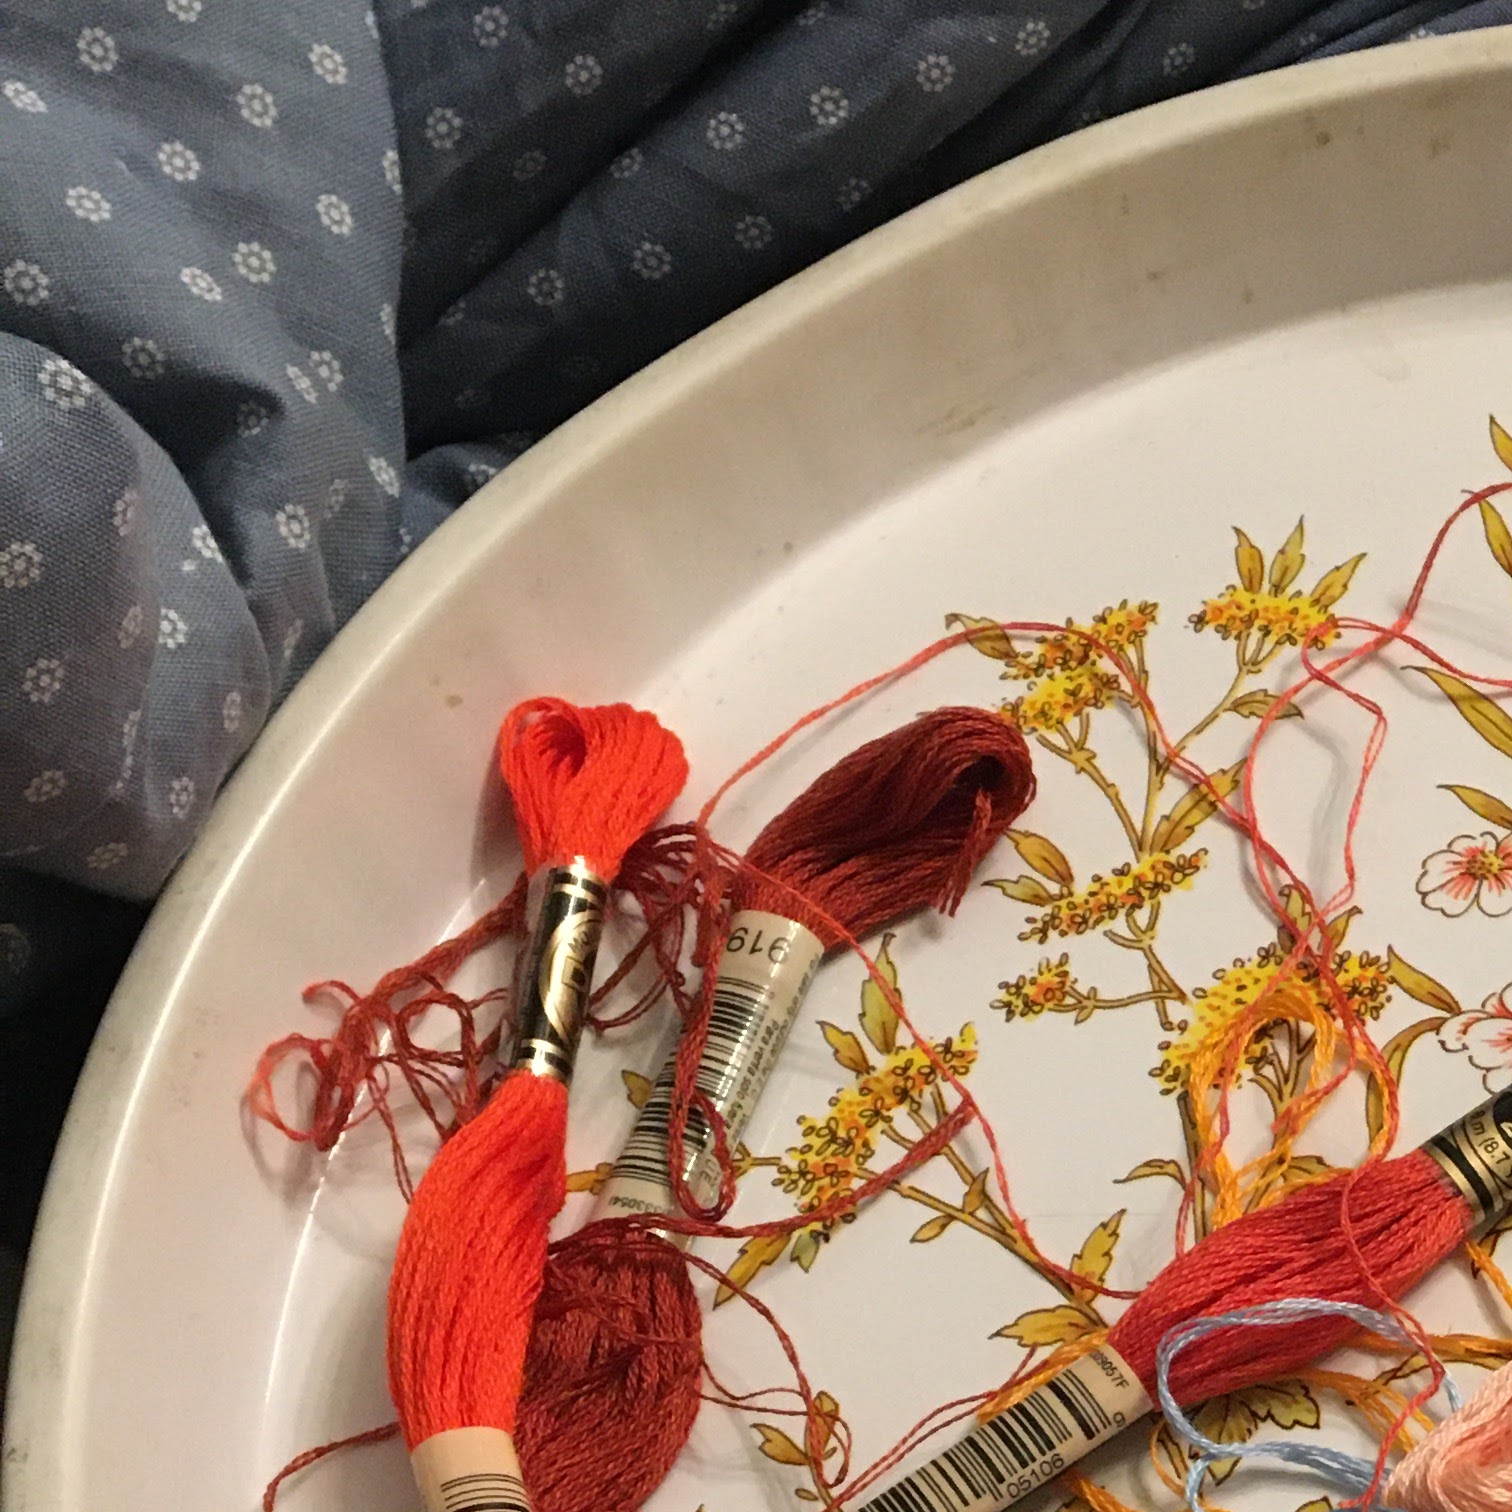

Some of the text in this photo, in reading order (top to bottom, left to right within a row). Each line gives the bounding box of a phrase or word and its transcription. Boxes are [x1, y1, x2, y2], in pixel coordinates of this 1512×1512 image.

[723, 921, 792, 967] 919
[1002, 1450, 1067, 1501] 05106
[1108, 1408, 1129, 1430] 9
